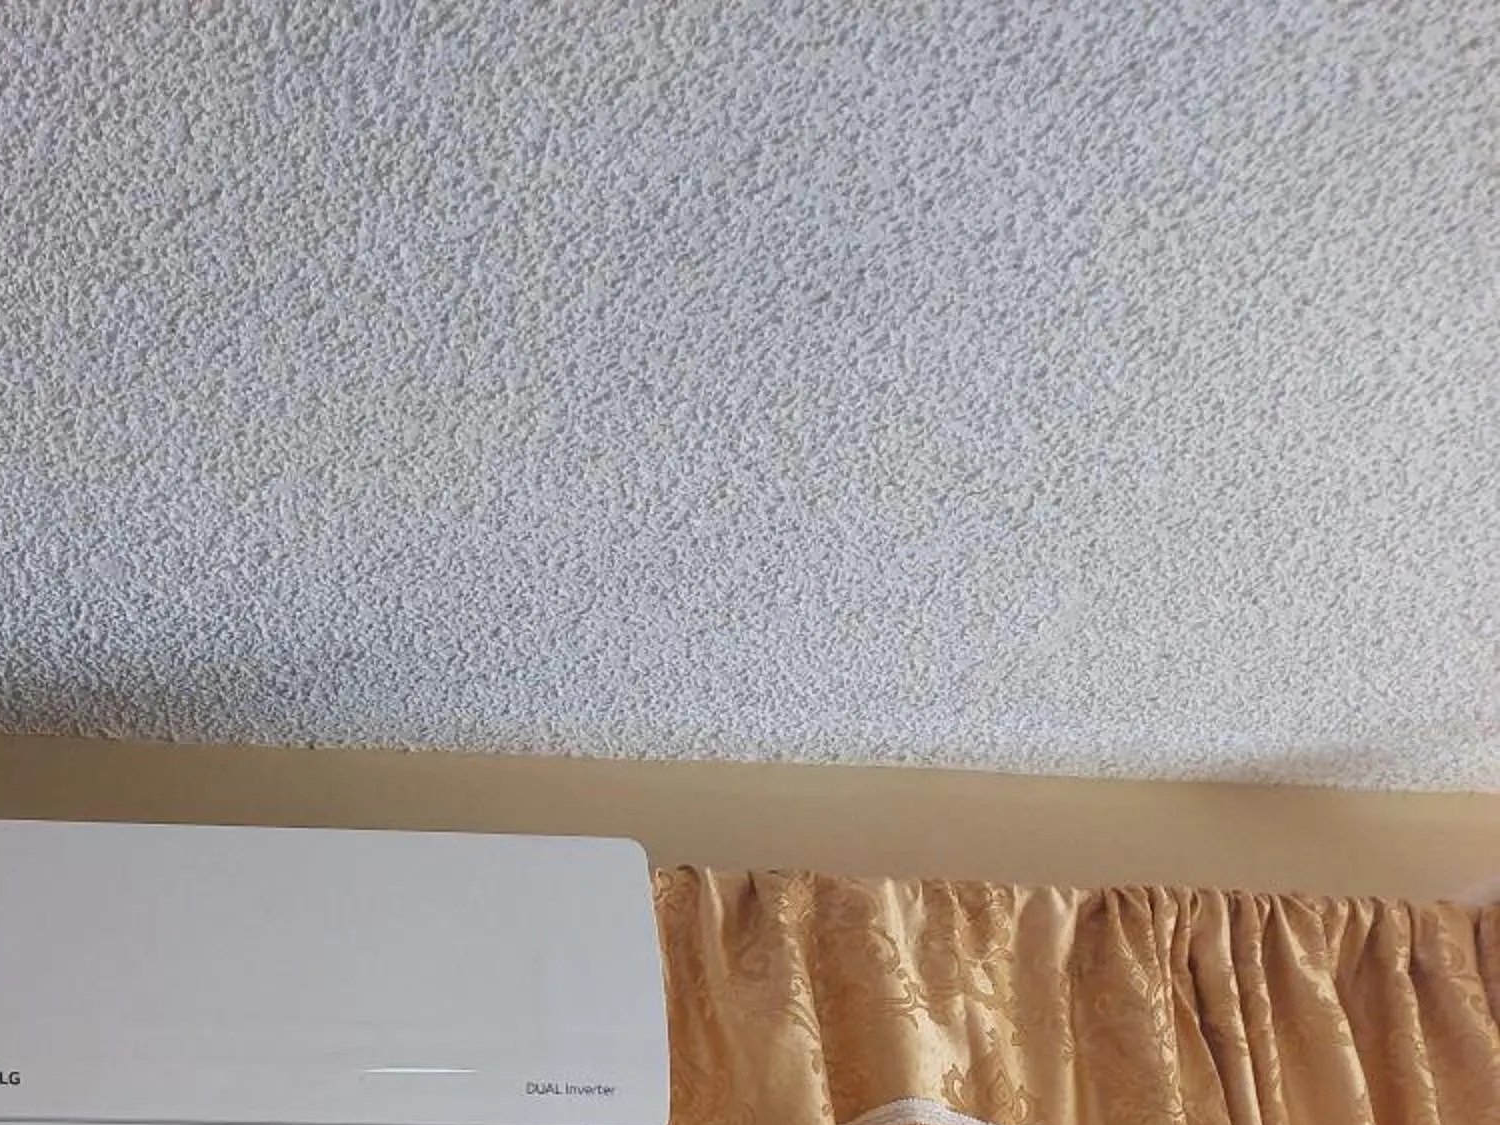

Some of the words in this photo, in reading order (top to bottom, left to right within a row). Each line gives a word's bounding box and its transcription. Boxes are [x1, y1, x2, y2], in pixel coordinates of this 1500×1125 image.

[0, 1071, 21, 1085] LG
[526, 1081, 563, 1095] DUAL
[564, 1081, 615, 1096] Inverter
